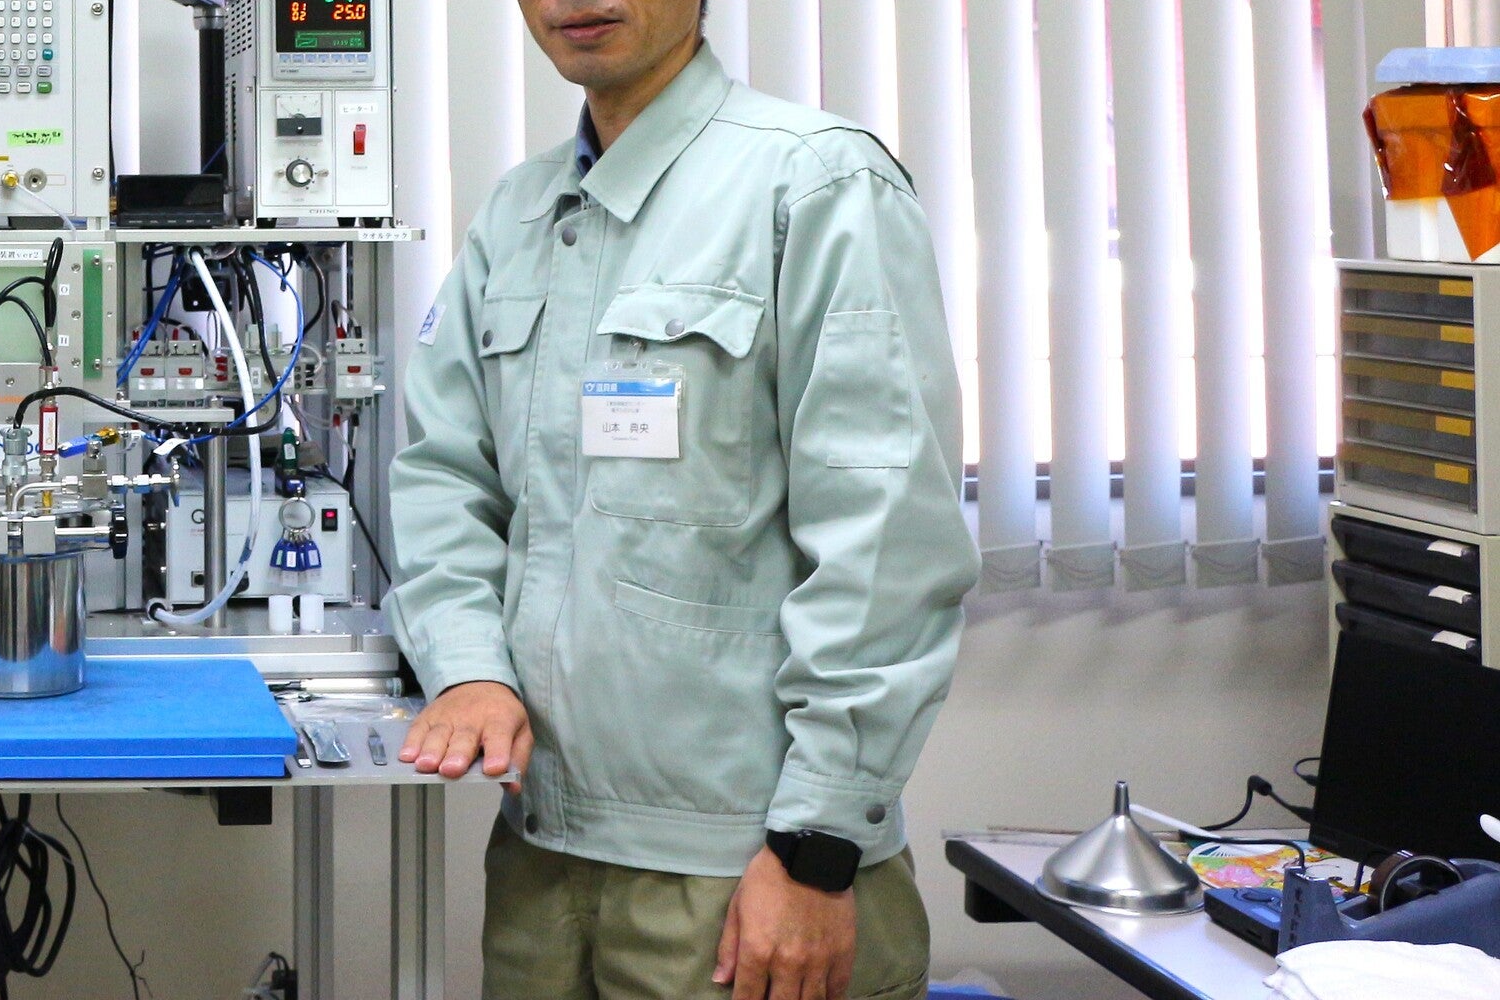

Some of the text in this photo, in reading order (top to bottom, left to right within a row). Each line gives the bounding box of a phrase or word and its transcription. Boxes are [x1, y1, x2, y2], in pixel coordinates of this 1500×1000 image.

[291, 1, 307, 11] 01
[291, 11, 307, 21] 02
[333, 4, 366, 20] 25.0
[603, 423, 620, 433] 山本
